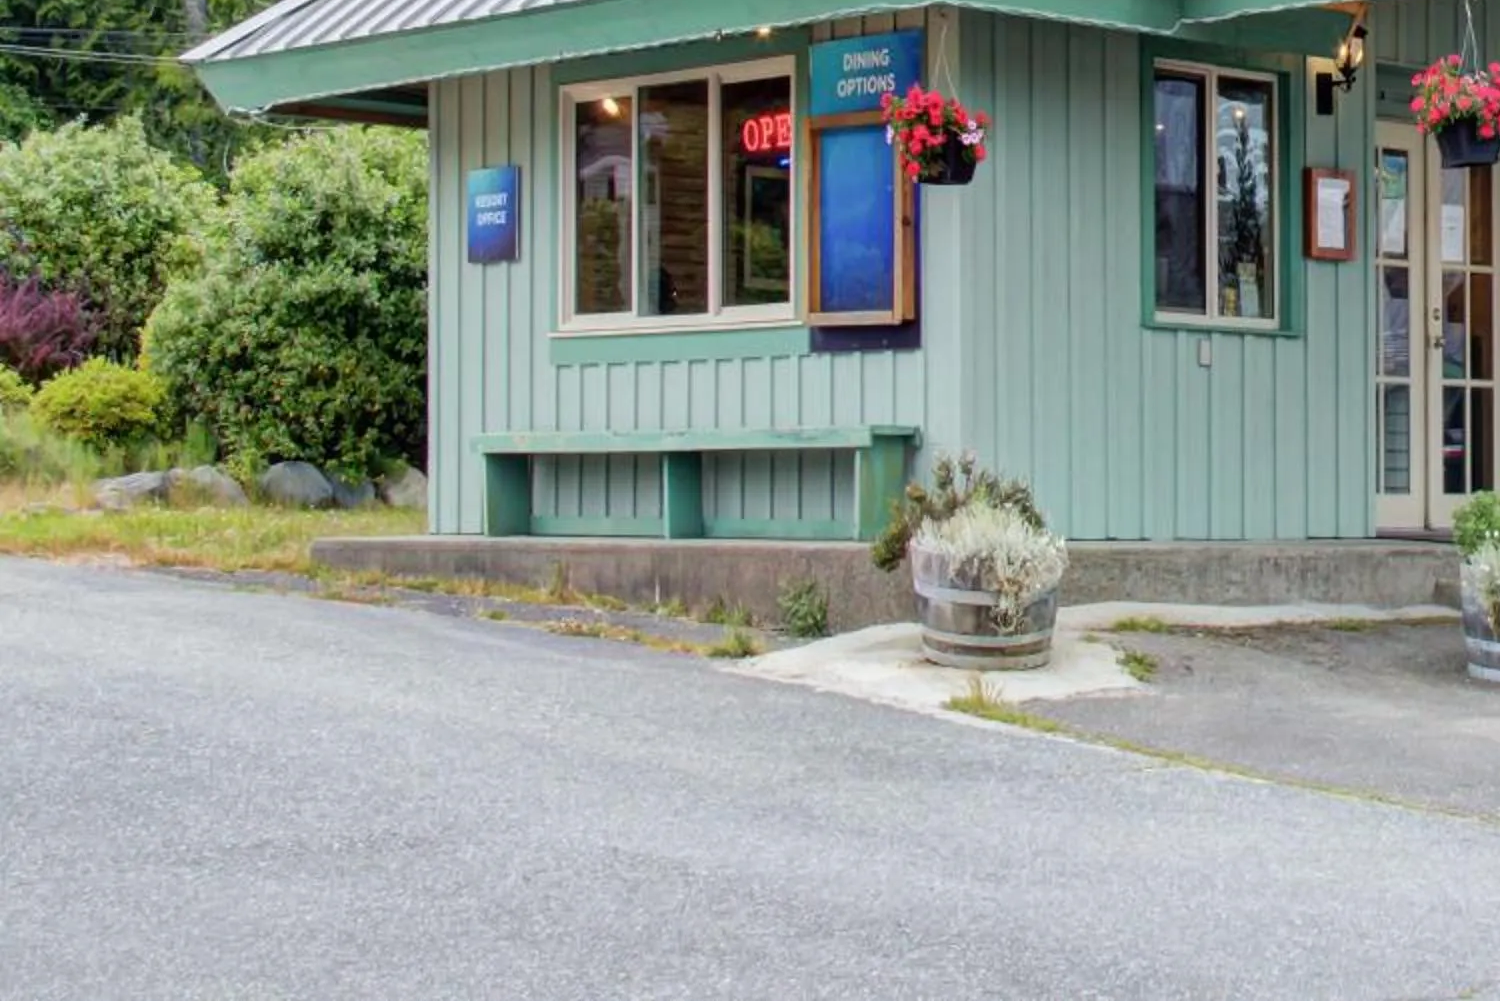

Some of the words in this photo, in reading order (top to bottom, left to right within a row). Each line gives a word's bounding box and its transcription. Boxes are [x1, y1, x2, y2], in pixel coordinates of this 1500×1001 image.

[843, 48, 890, 72] DINING
[837, 73, 896, 98] OPTIONS
[743, 113, 791, 151] OPE
